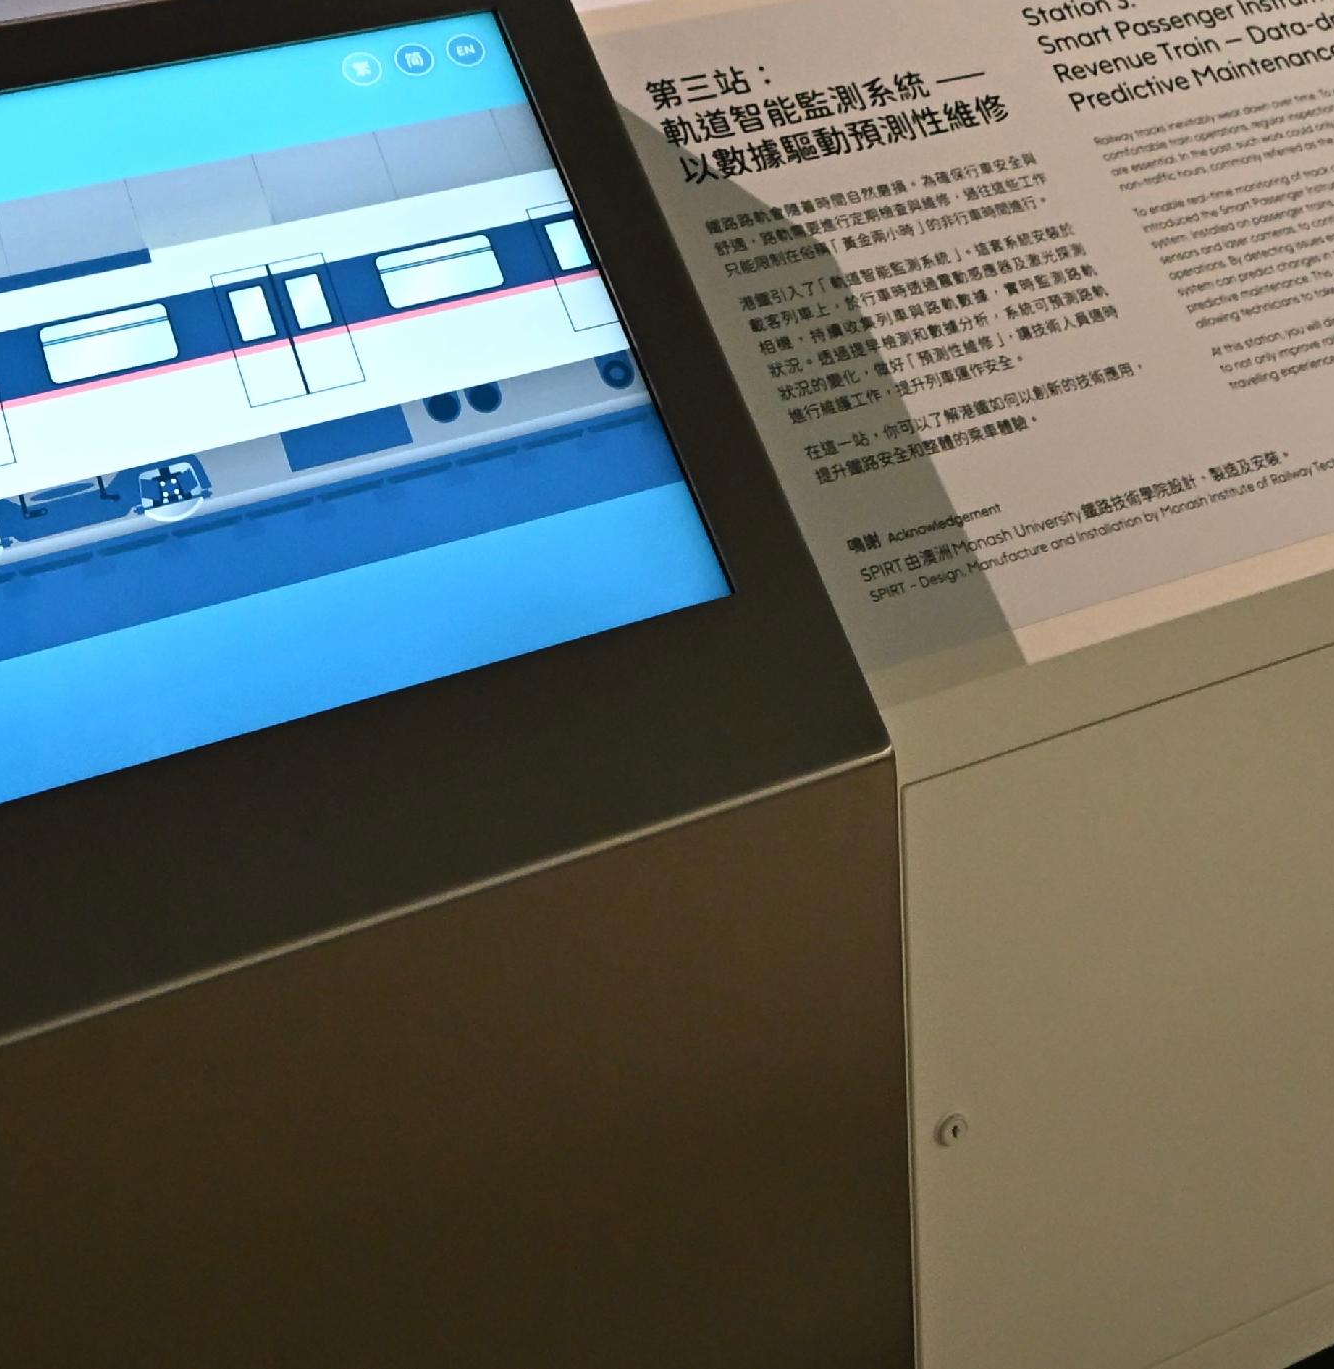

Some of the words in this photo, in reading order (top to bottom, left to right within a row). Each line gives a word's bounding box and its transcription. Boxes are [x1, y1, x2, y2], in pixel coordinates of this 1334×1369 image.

[456, 43, 475, 57] EN
[1036, 24, 1113, 55] Smart
[1113, 3, 1235, 41] Passenger
[1051, 50, 1158, 84] Revenue
[1155, 35, 1222, 62] Train
[645, 65, 772, 112] 第三站：
[659, 71, 932, 149] 軌道智能監測系統
[1067, 74, 1191, 113] Predictive
[679, 93, 1010, 185] 以數據驅動預測性維修
[1092, 132, 1135, 146] Railway
[1216, 108, 1242, 121] wear
[1241, 102, 1271, 116] down
[1101, 140, 1169, 163] comfortable
[1167, 134, 1194, 147] train
[1250, 114, 1286, 131] regular
[1109, 165, 1130, 178] are
[1188, 148, 1209, 159] the
[1260, 131, 1286, 144] work
[1284, 123, 1316, 139] could
[1118, 170, 1178, 193] non-traffic
[1208, 152, 1263, 173] commonly
[1131, 206, 1149, 218] To
[1148, 199, 1186, 216] enable
[1233, 174, 1292, 195] monitoring
[1289, 169, 1303, 183] of
[1141, 211, 1201, 234] introduced
[1198, 208, 1220, 220] the
[1218, 199, 1253, 216] Smart
[1250, 188, 1305, 207] Passenger
[1250, 205, 1305, 228] passenger
[1199, 241, 1224, 256] and
[1226, 254, 1243, 267] By
[1214, 274, 1238, 288] can
[1237, 263, 1276, 284] predict
[1275, 254, 1323, 274] changes
[1185, 292, 1240, 316] predictive
[1194, 310, 1242, 330] allowing
[1210, 345, 1223, 358] At
[1222, 341, 1245, 354] this
[1283, 326, 1306, 341] you
[1305, 319, 1323, 333] will
[1218, 363, 1235, 374] to
[1232, 356, 1254, 371] not
[1253, 351, 1278, 366] only
[1276, 339, 1322, 359] improve
[1227, 369, 1282, 390] travelling
[868, 580, 907, 604] SPIRT
[965, 542, 1050, 574] Manufacture
[1049, 532, 1077, 551] and
[1074, 515, 1144, 543] Installation
[1141, 511, 1160, 524] by
[1158, 495, 1209, 518] Monash
[1206, 482, 1257, 504] Institute
[1255, 474, 1270, 491] of
[1268, 465, 1314, 486] Railway
[887, 502, 1002, 545] Acknowledgement
[859, 557, 904, 583] SPIRT
[950, 528, 1015, 557] Monash
[1011, 509, 1083, 539] University
